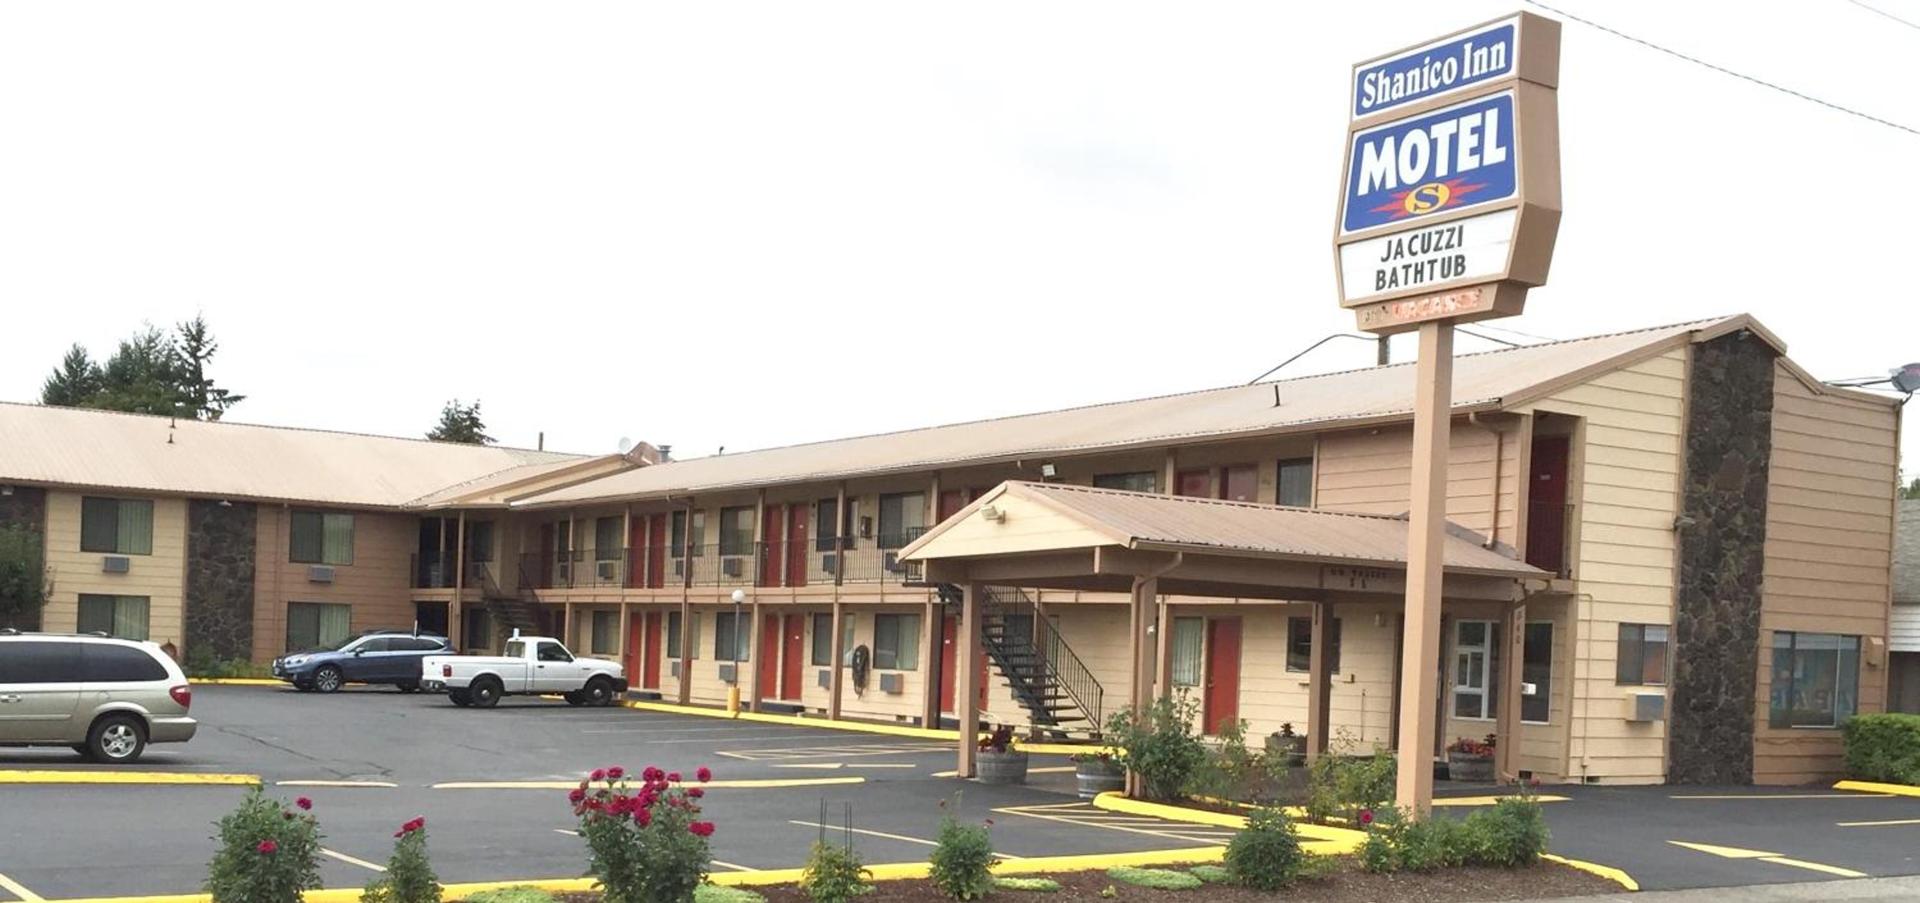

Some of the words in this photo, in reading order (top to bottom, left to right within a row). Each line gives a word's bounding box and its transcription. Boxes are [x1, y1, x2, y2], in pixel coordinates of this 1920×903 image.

[1361, 56, 1457, 109] Shanico
[1462, 41, 1506, 78] Inn
[1357, 107, 1506, 197] MOTEL
[1413, 185, 1440, 212] S
[1381, 225, 1464, 262] JACUZZI
[1375, 255, 1466, 291] BATHTUB
